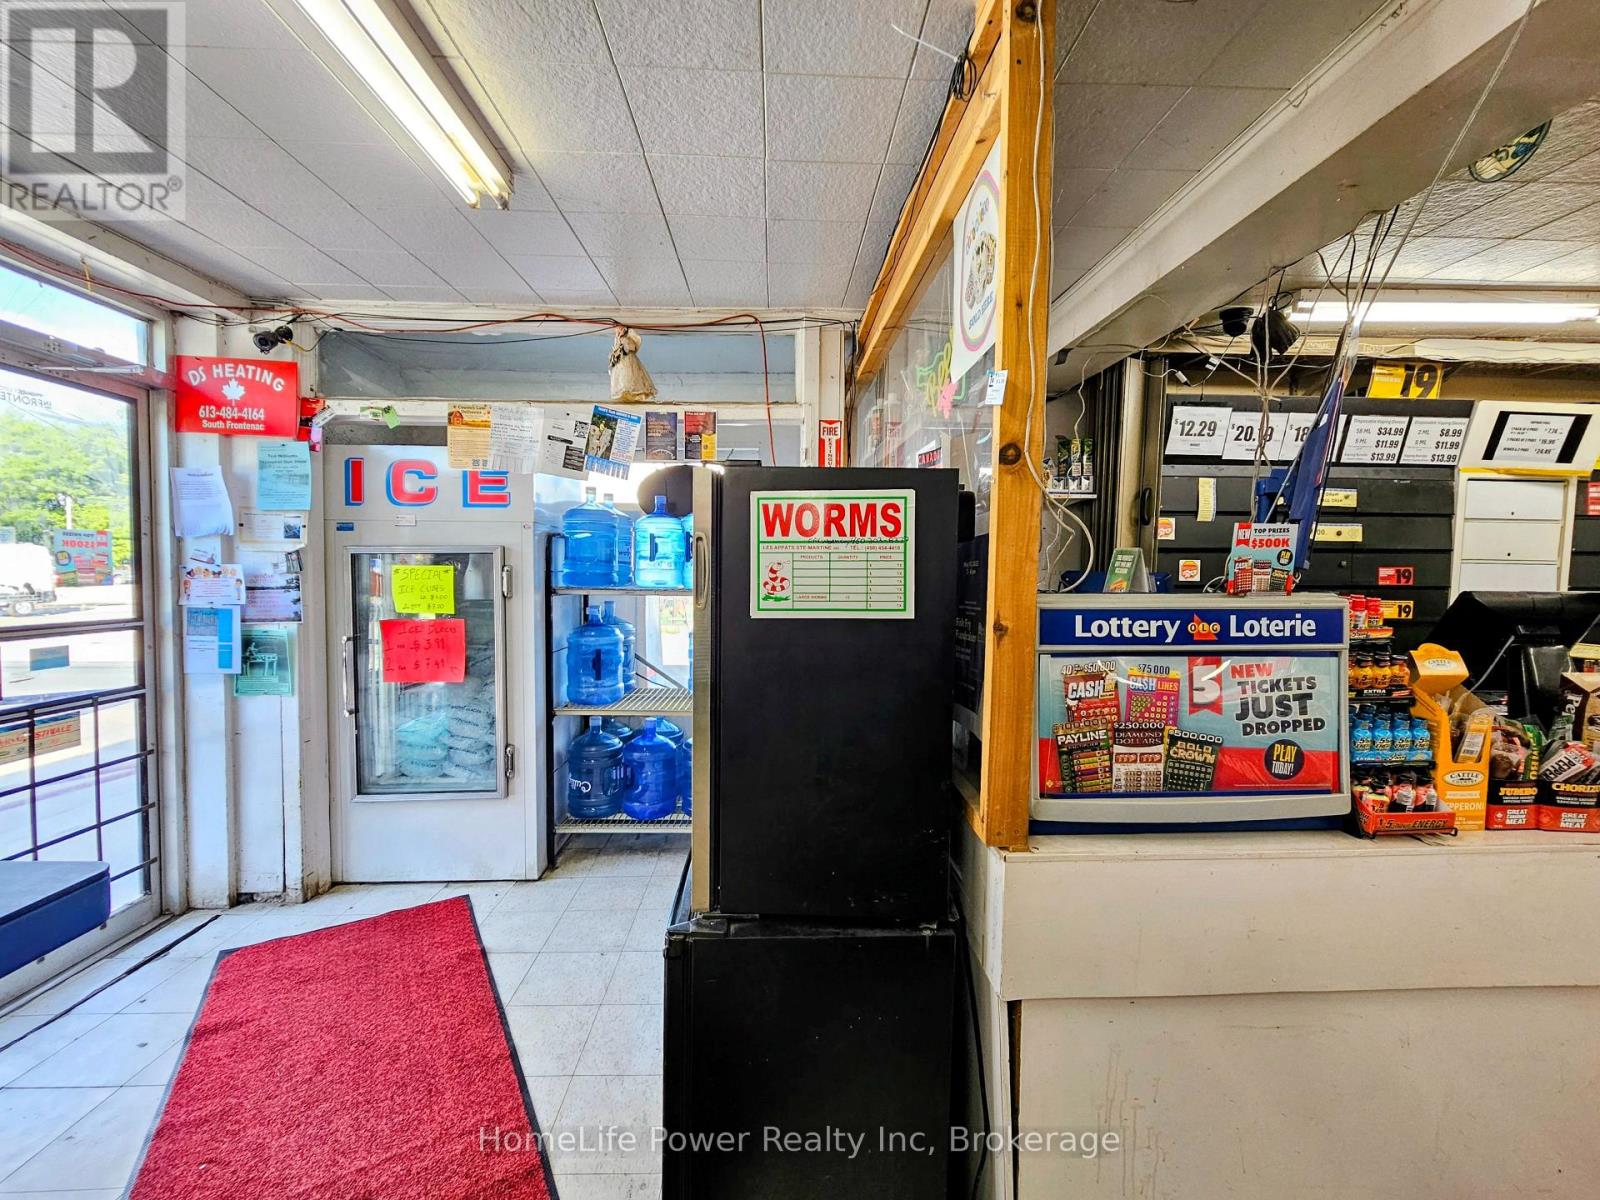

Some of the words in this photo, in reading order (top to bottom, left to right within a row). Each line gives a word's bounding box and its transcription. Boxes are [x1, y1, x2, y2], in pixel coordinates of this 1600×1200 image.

[188, 366, 207, 386] DS
[212, 363, 286, 392] HEATING
[1401, 363, 1440, 399] 19
[199, 405, 265, 421] 613-484-4164
[202, 420, 224, 429] South
[226, 421, 265, 431] Frontenac
[822, 426, 839, 436] FIRE
[1174, 418, 1218, 438] $12.29
[1377, 427, 1404, 436] $34.99
[1440, 429, 1463, 437] $8.99
[1375, 439, 1399, 448] $11.99
[1435, 441, 1460, 450] $11.99
[1370, 453, 1396, 462] $13.99
[1431, 454, 1457, 463] $13.99
[345, 457, 511, 508] ICE
[762, 503, 902, 538] WORMS
[1251, 538, 1289, 549] $500K
[1395, 569, 1412, 584] 19
[1397, 604, 1412, 618] 19
[1075, 614, 1181, 643] Lottery
[1187, 622, 1221, 634] OLG
[1229, 613, 1316, 638] Loterie
[1061, 664, 1073, 675] 40
[1067, 680, 1104, 700] CASH
[1157, 681, 1179, 691] LINES
[1193, 665, 1221, 704] 5
[1230, 663, 1273, 679] NEW
[1237, 676, 1317, 695] TICKETS
[1236, 693, 1313, 721] JUST
[1242, 717, 1326, 736] DROPPED
[1057, 729, 1108, 746] PAYLINE
[1168, 729, 1223, 743] $500,000
[1170, 748, 1215, 764] CROWN
[1273, 743, 1297, 762] PLAY
[1272, 760, 1295, 776] TODAY!
[1499, 787, 1538, 796] JUMBO
